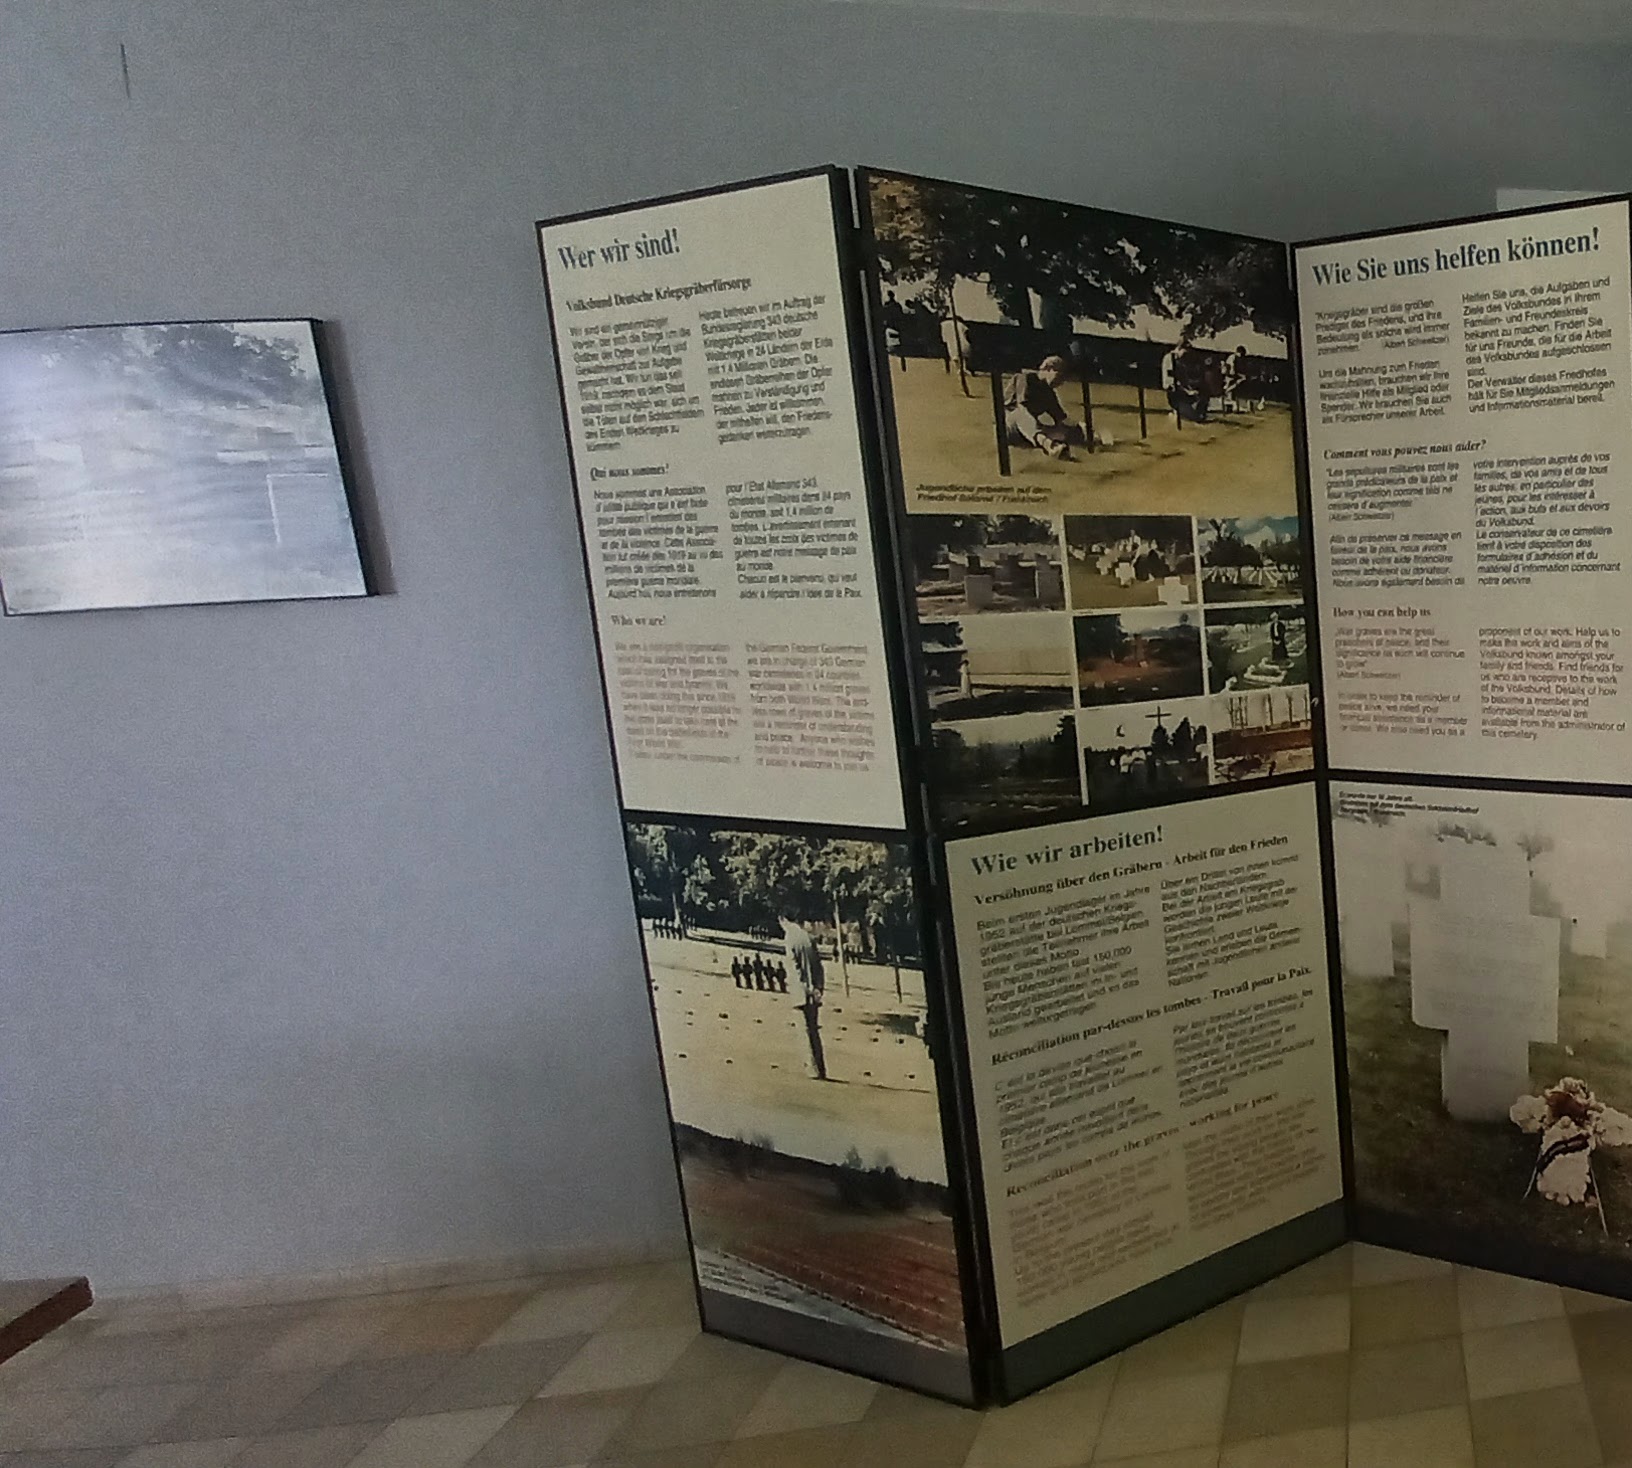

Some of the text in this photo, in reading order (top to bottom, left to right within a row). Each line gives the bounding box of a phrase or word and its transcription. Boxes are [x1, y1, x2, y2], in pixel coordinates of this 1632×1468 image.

[557, 227, 680, 270] Wer wir sind!
[1312, 226, 1600, 287] Wie Sie uns helfen können!
[1492, 290, 1507, 300] Sie
[1546, 280, 1590, 296] Aufgaben
[1592, 277, 1610, 288] und
[1563, 295, 1572, 305] in
[1506, 313, 1523, 324] und
[1525, 306, 1588, 322] Freundeskreis
[1464, 329, 1500, 341] bekannt
[1555, 318, 1586, 331] Finden
[1469, 402, 1485, 413] und
[1324, 449, 1368, 460] Comment
[1371, 448, 1393, 457] vous
[969, 824, 1163, 876] Wie wir arbeiten!
[974, 882, 1054, 905] Versöhnung
[1056, 868, 1085, 890] über
[1088, 868, 1111, 884] den
[1173, 848, 1208, 866] Arbeit
[1209, 846, 1227, 860] für
[1228, 842, 1249, 856] den
[1250, 834, 1289, 851] Frieden
